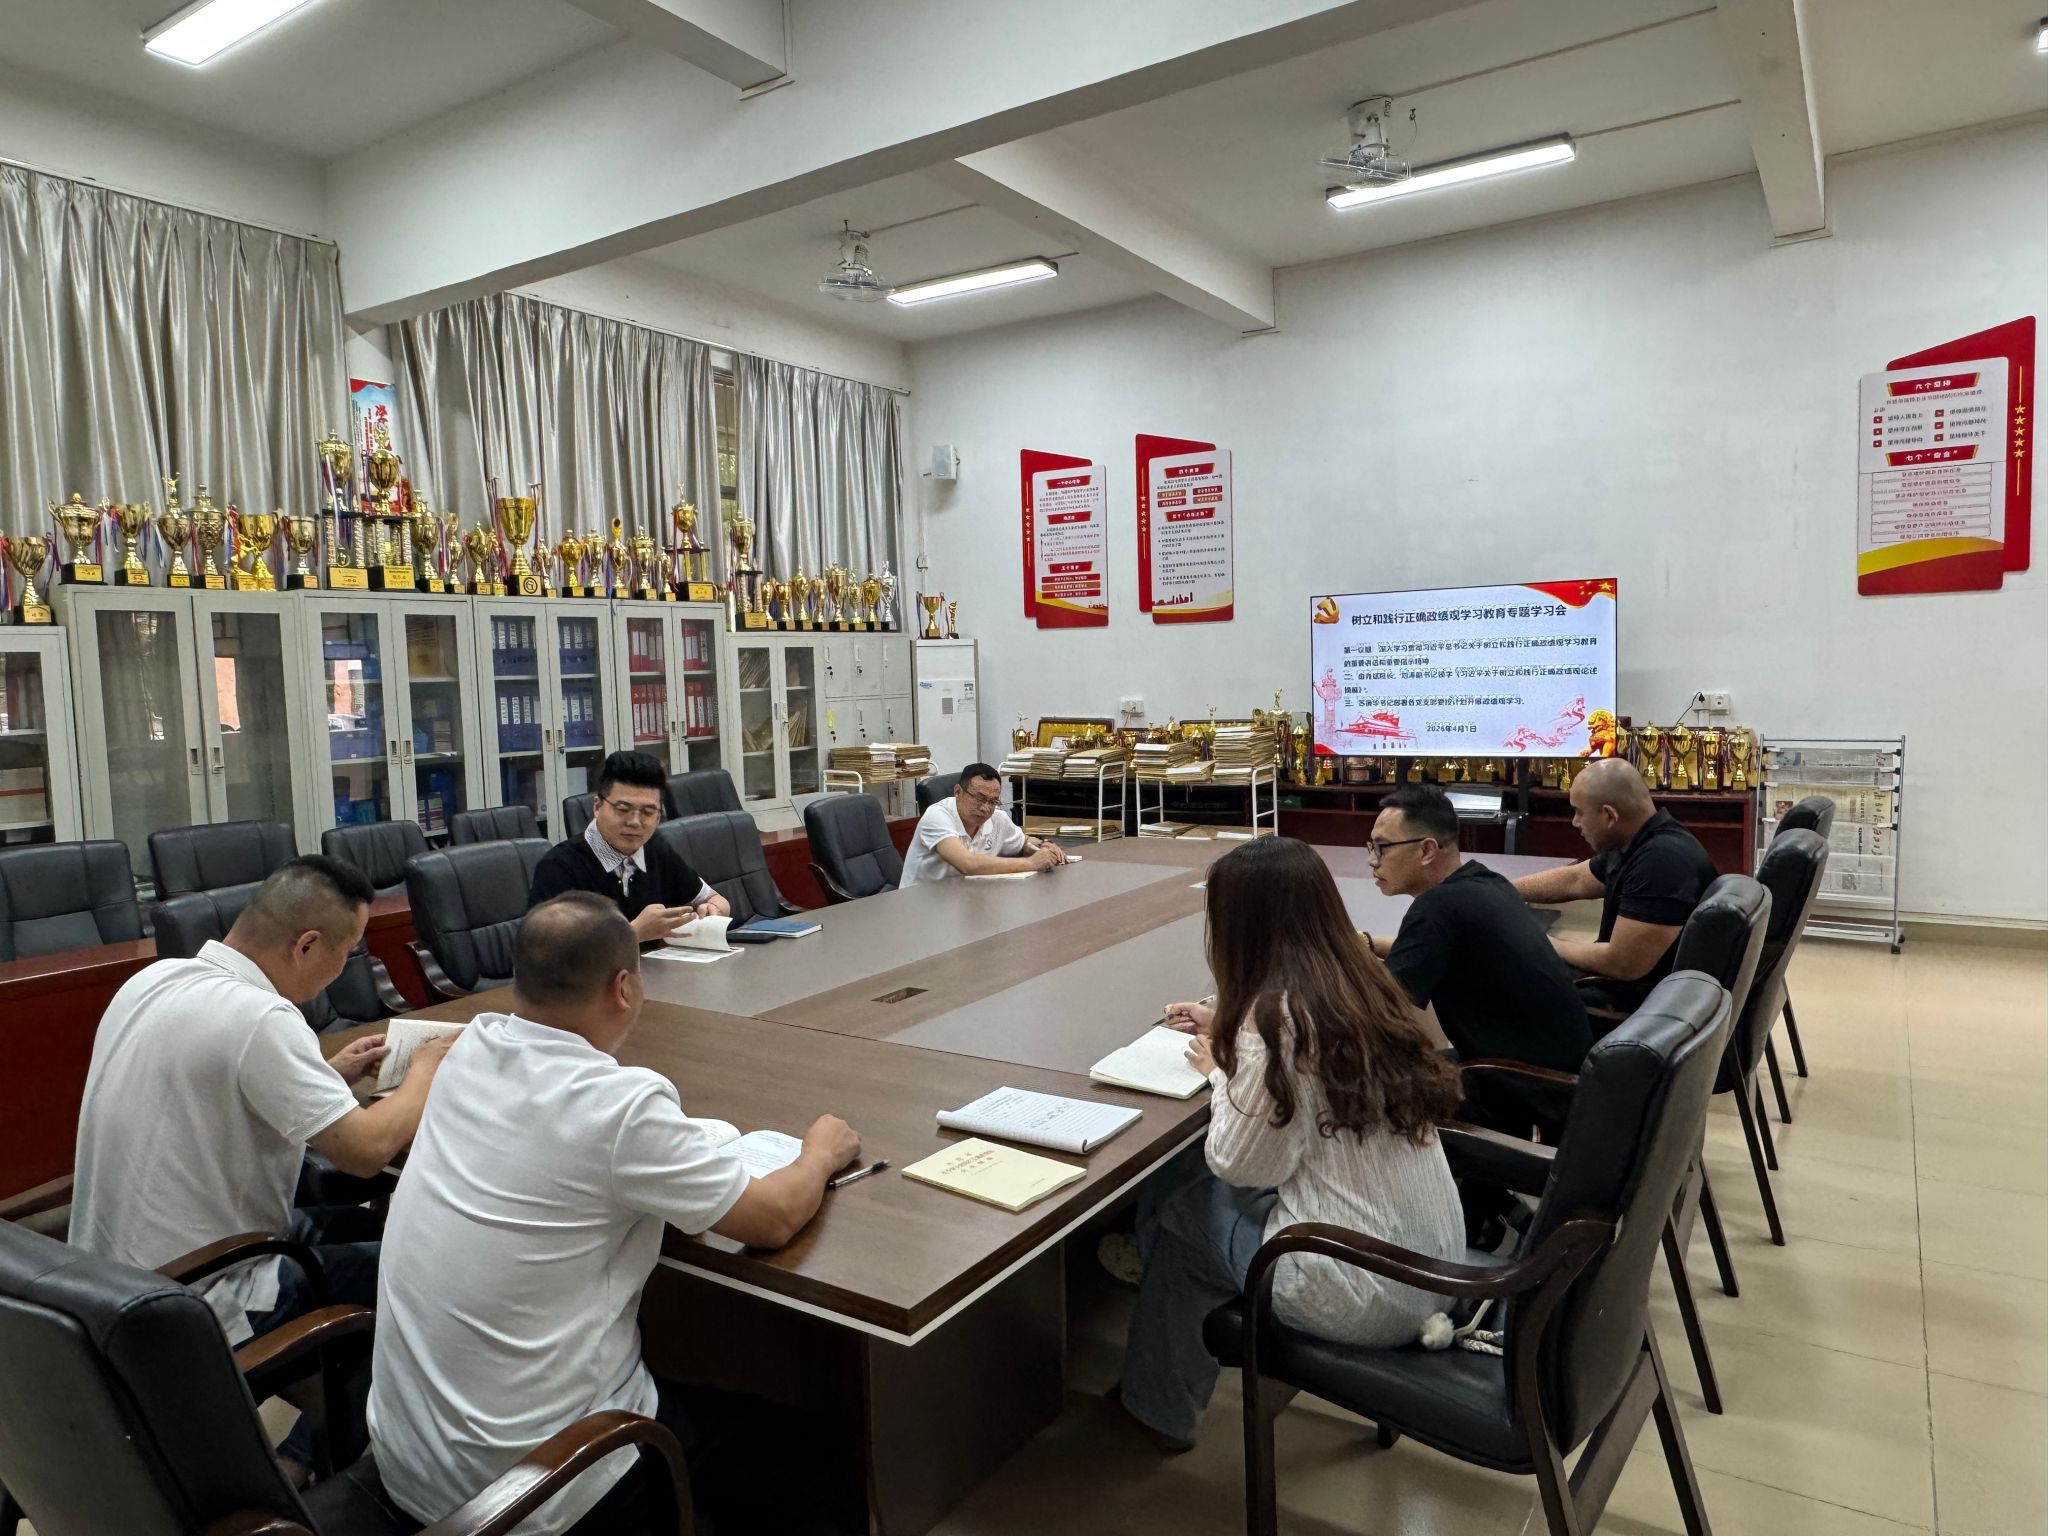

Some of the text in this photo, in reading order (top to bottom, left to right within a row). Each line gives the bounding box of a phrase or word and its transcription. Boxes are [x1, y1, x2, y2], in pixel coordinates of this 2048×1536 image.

[1352, 604, 1566, 625] 树立和践行正确政绩观学习教育专题学习会
[1426, 725, 1477, 733] 2026年4月1日
